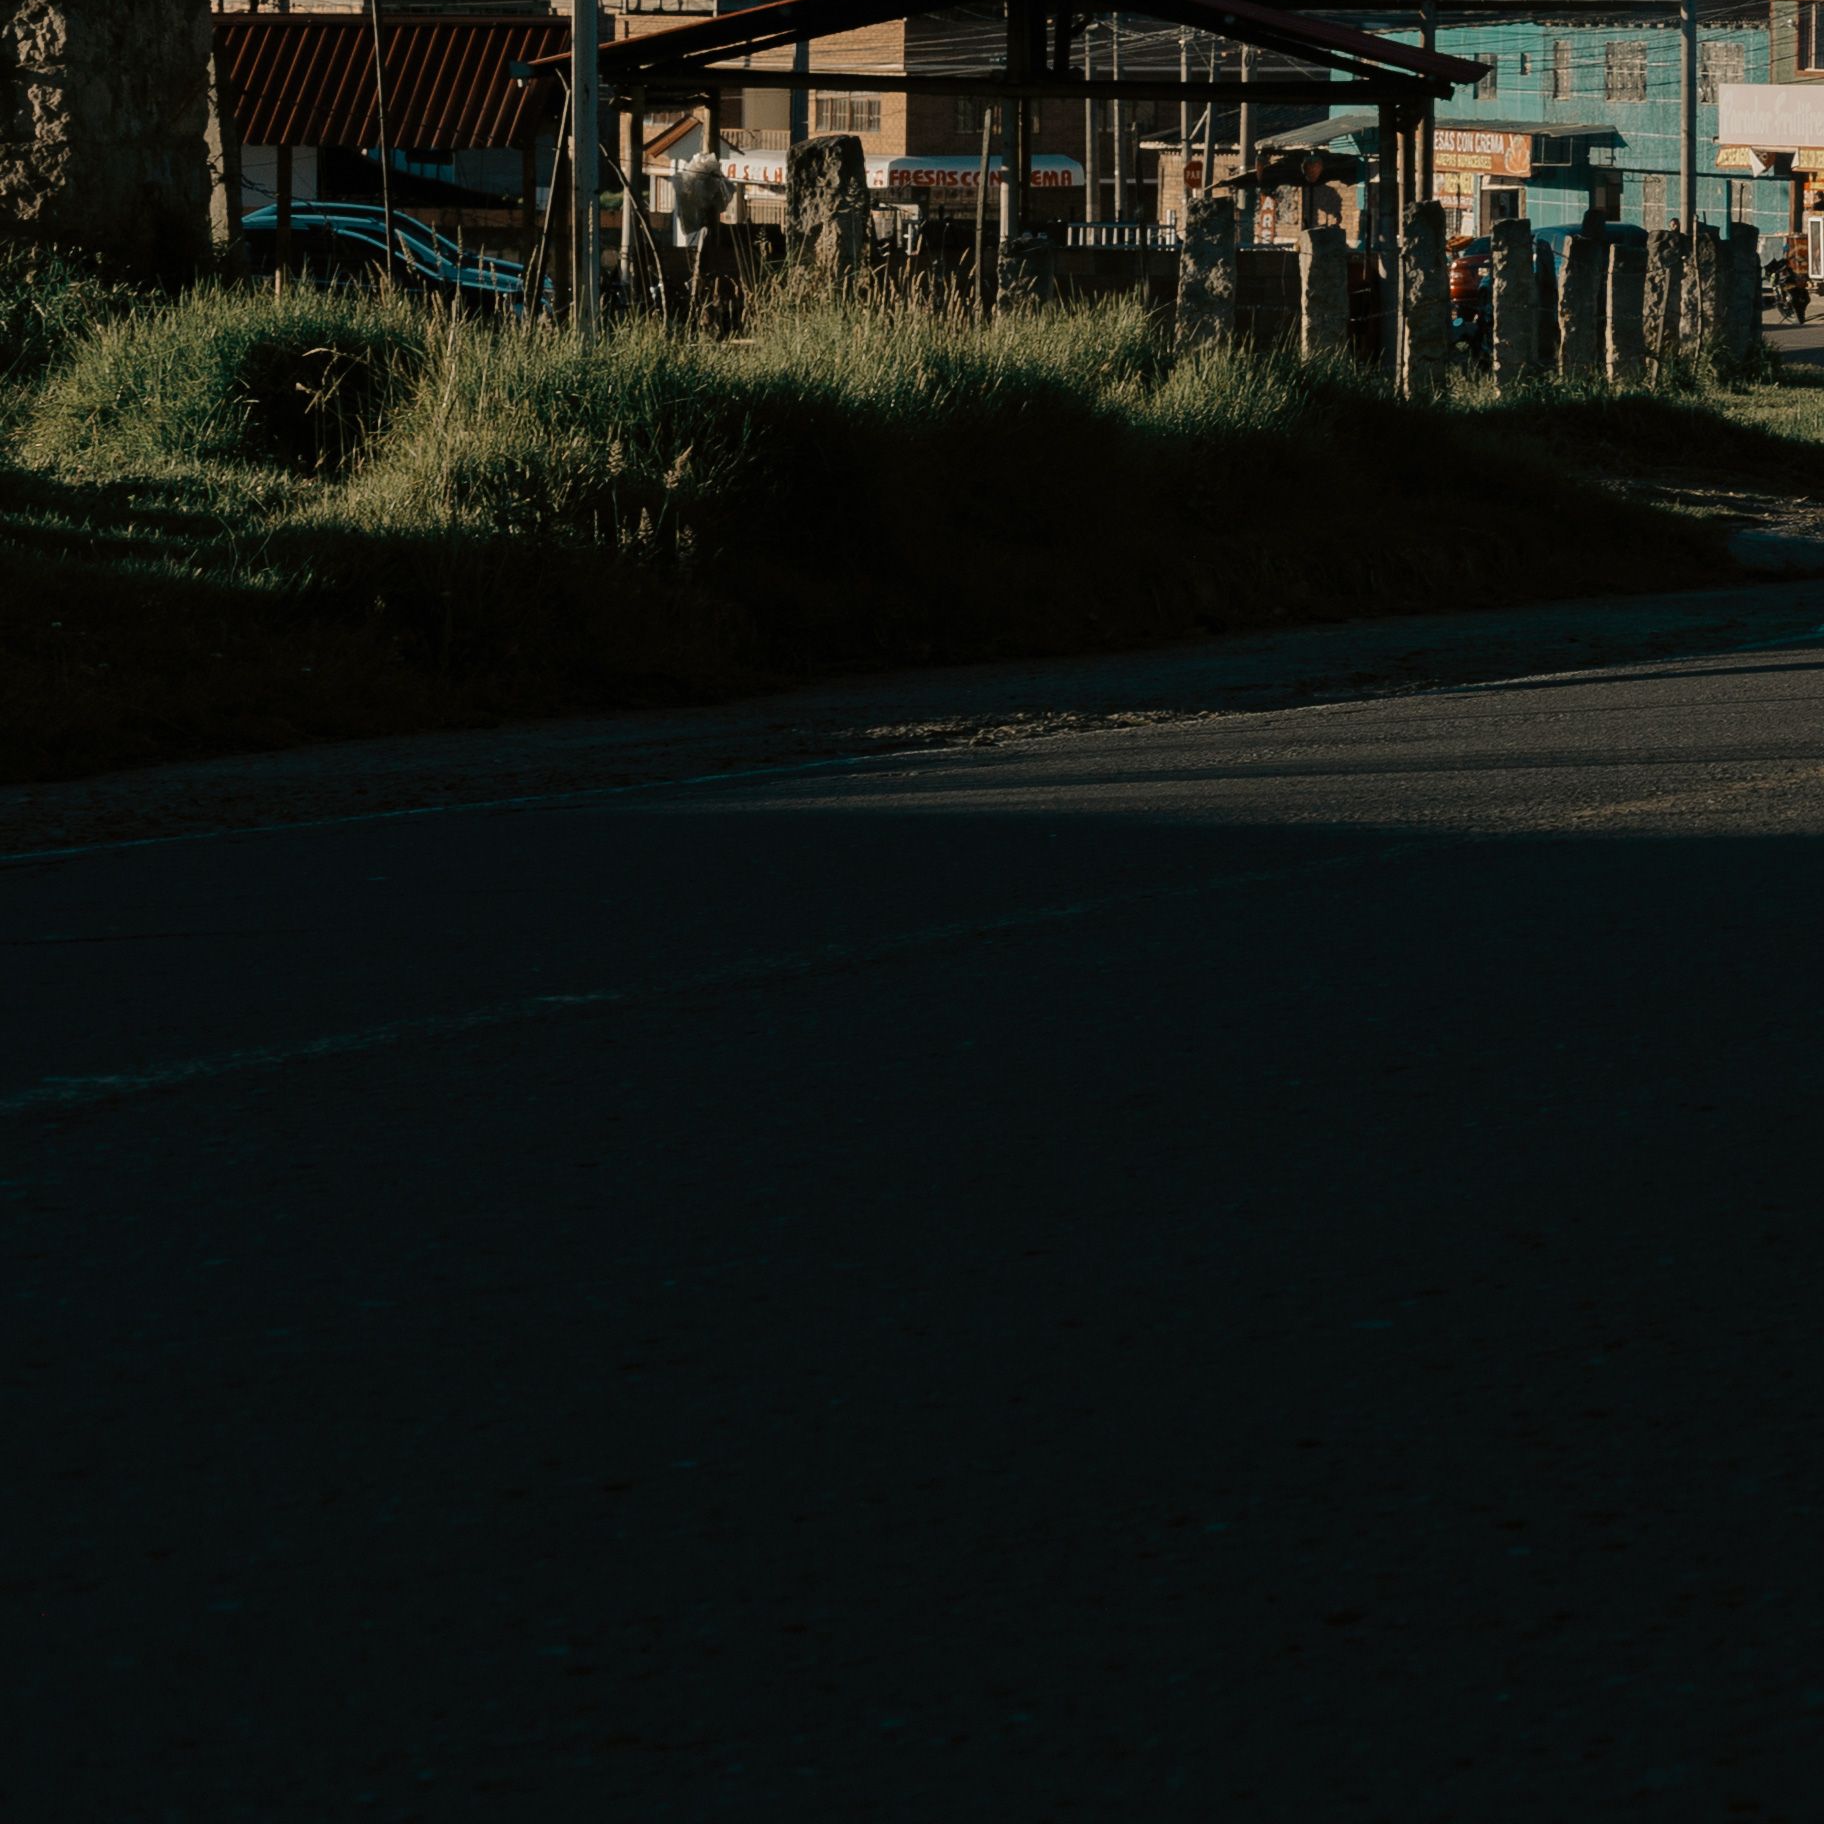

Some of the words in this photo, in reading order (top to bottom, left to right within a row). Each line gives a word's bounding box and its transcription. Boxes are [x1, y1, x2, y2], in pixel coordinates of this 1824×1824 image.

[1434, 131, 1456, 151] ESAS
[1456, 132, 1473, 152] CON
[1475, 133, 1505, 154] CREMA
[890, 169, 958, 187] FRESAS
[1031, 170, 1073, 187] EMA
